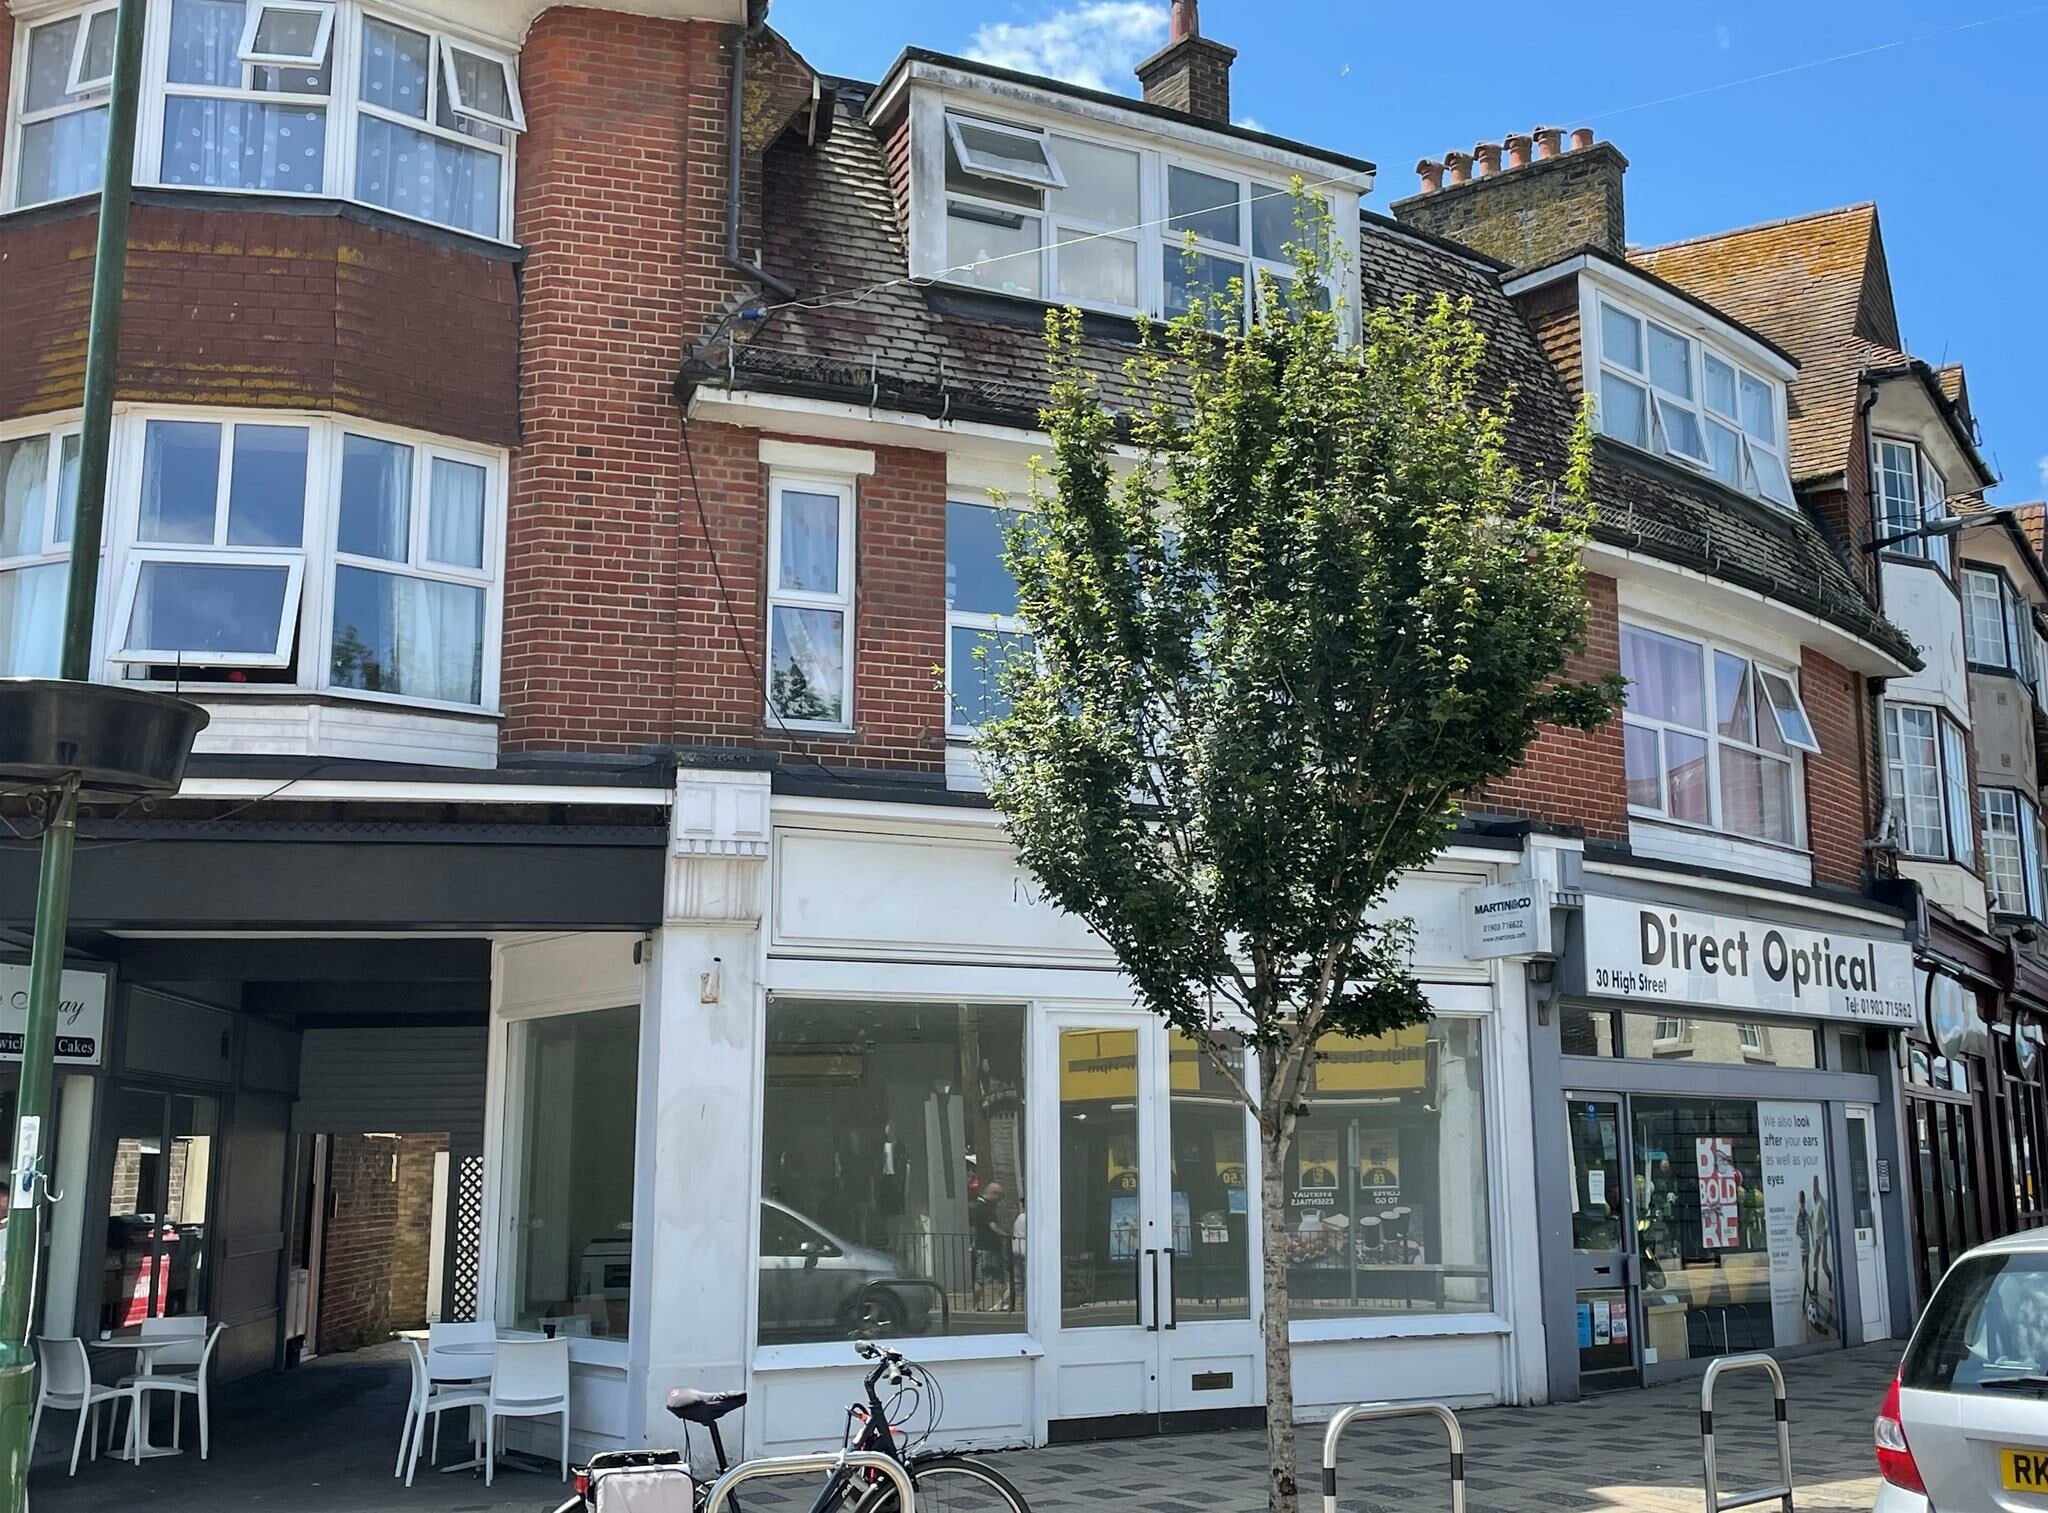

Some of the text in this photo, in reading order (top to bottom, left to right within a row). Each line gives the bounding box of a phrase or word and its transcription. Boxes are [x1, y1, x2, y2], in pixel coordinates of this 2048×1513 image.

[1475, 898, 1531, 915] MARTIN&CO
[1640, 910, 1877, 997] Direct Optical
[1596, 968, 1667, 994] 30 High Street
[1861, 999, 1884, 1016] 01903
[1885, 1001, 1913, 1019] 715962
[58, 1039, 94, 1053] Cakes
[1763, 1114, 1811, 1128] We also look
[1764, 1132, 1819, 1149] after your ears
[1765, 1152, 1819, 1168] as well as your
[1766, 1175, 1785, 1188] eyes
[1699, 1179, 1738, 1206] BOLD
[2013, 1454, 2048, 1486] RK
